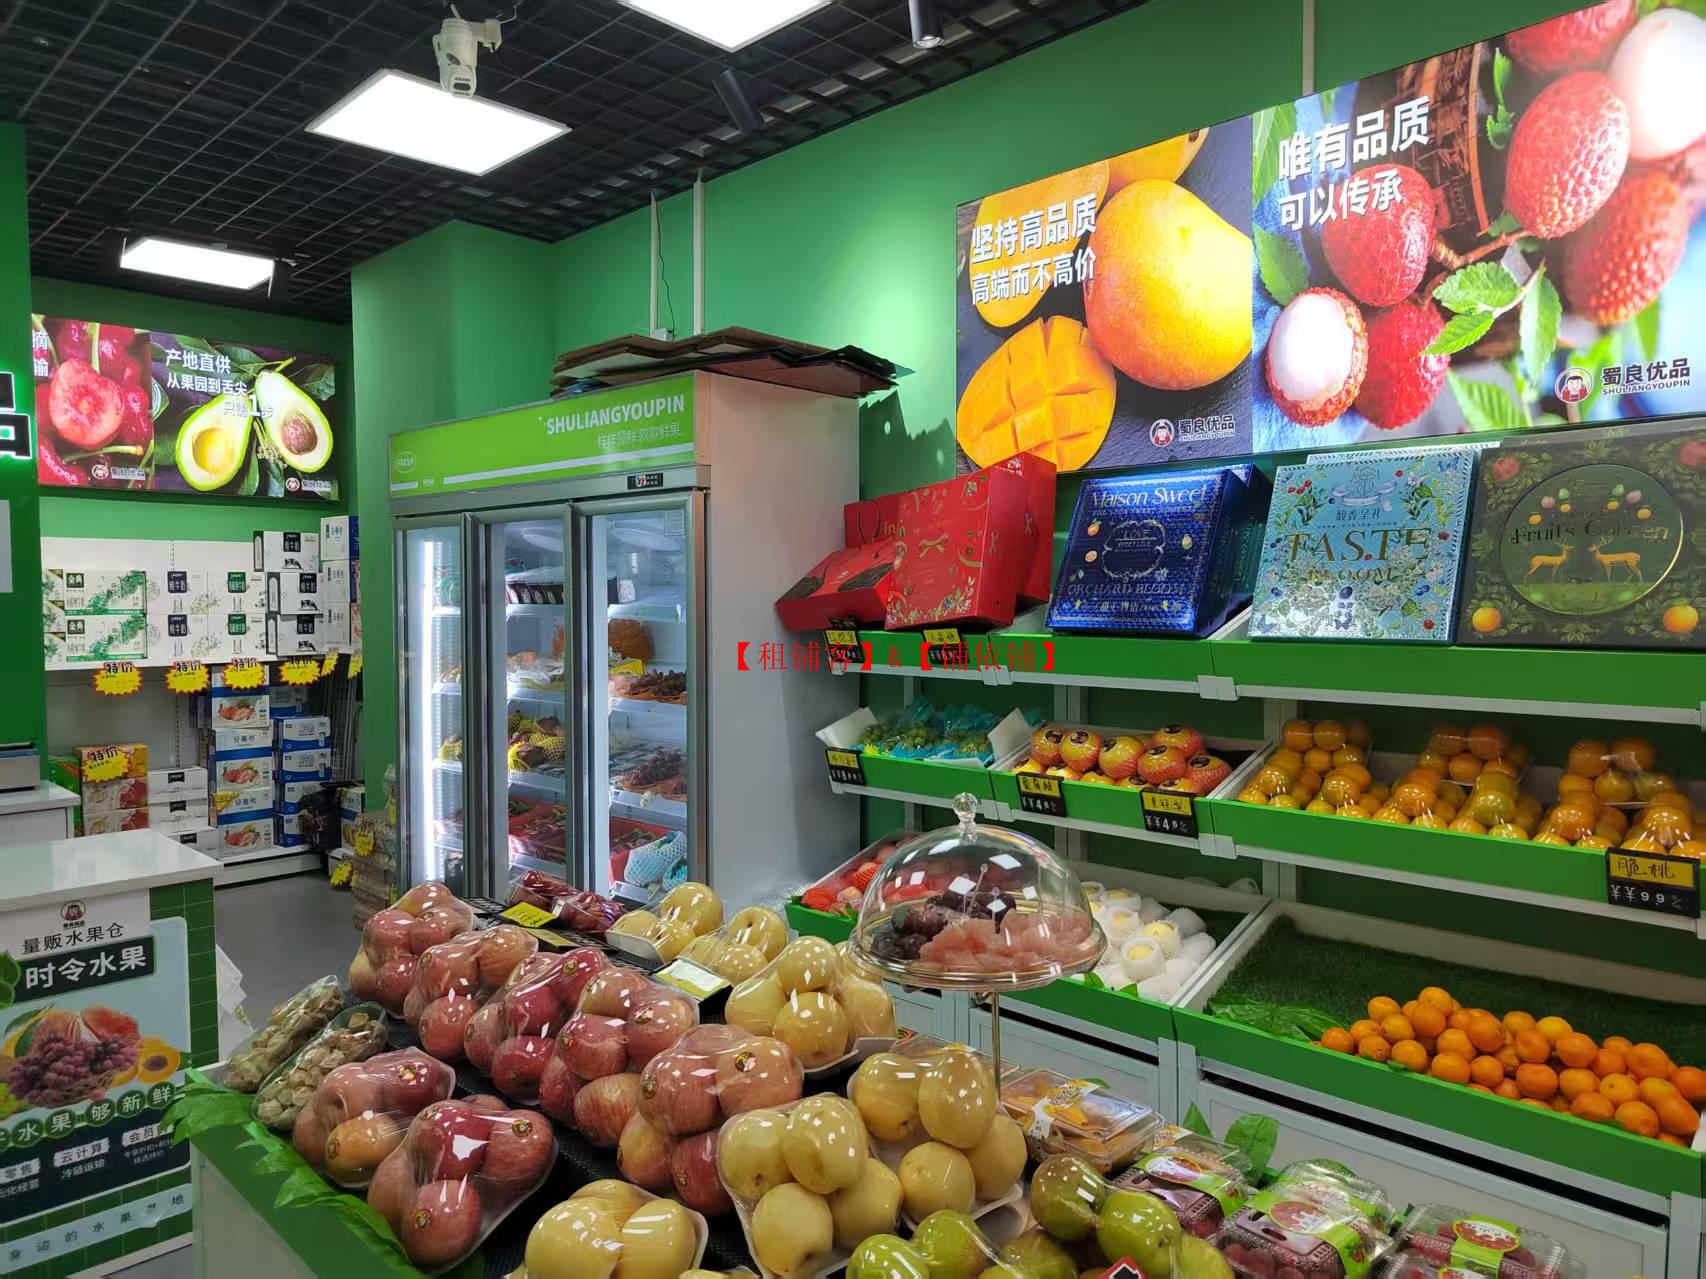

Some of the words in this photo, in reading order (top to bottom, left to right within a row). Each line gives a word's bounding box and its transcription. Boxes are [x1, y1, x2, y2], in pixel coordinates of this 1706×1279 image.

[1278, 95, 1431, 181] 唯有品质
[1279, 168, 1404, 231] 可以传承
[971, 193, 1097, 264] 坚持高品质
[971, 248, 1097, 305] 高端而不高价
[165, 348, 231, 375] 产地直供
[1603, 358, 1691, 386] 蜀良优品
[167, 371, 248, 397] 从果园到舌尖
[1602, 379, 1691, 396] SHULIANGYOUPIN
[546, 394, 684, 435] SHULIANGYOUPIN
[1179, 415, 1234, 434] 蜀良优品
[1284, 527, 1432, 562] TASTE
[22, 922, 125, 955] 量贩水果仓
[26, 945, 146, 989] 时令水果
